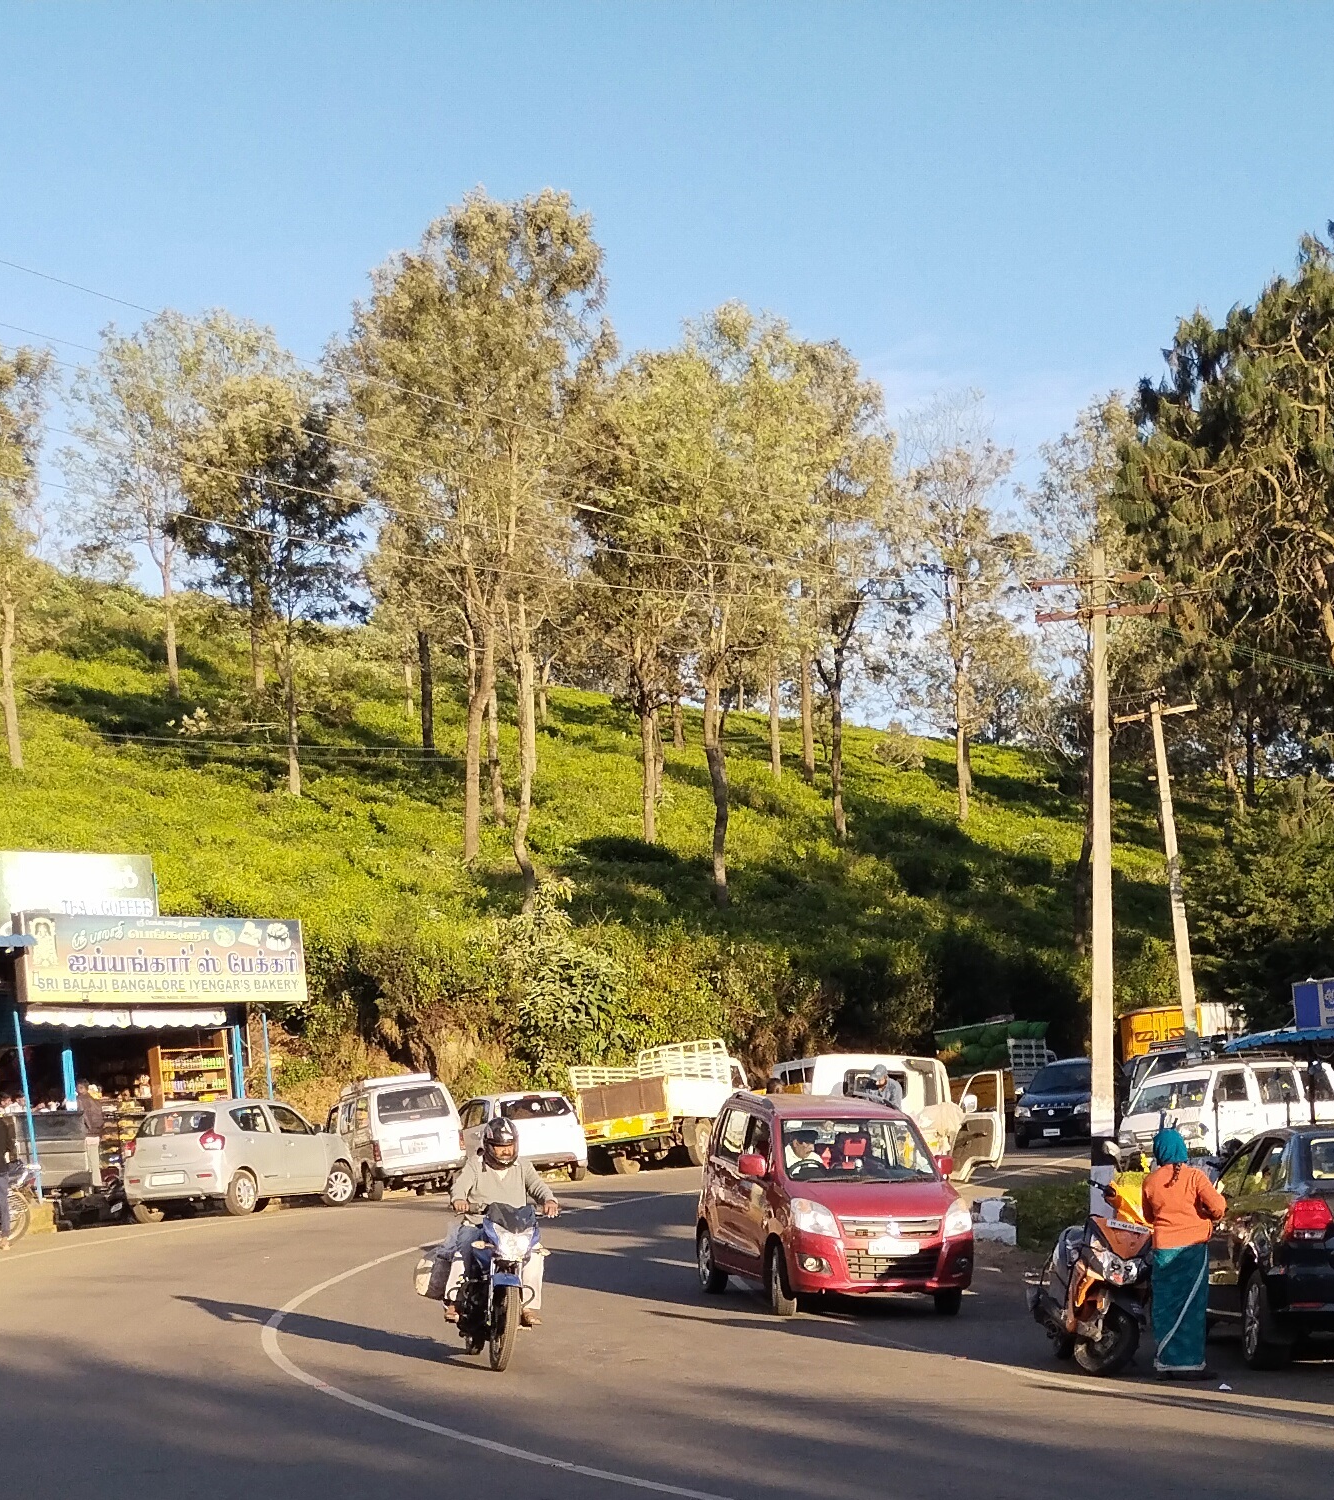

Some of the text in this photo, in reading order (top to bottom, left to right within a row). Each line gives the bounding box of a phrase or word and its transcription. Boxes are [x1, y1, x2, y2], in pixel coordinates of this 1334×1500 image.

[100, 900, 154, 916] COFFEE
[227, 949, 299, 974] பேக்கரி
[38, 978, 298, 990] SRI BALAJI BANGALORE IYENGAR'S BAKERY
